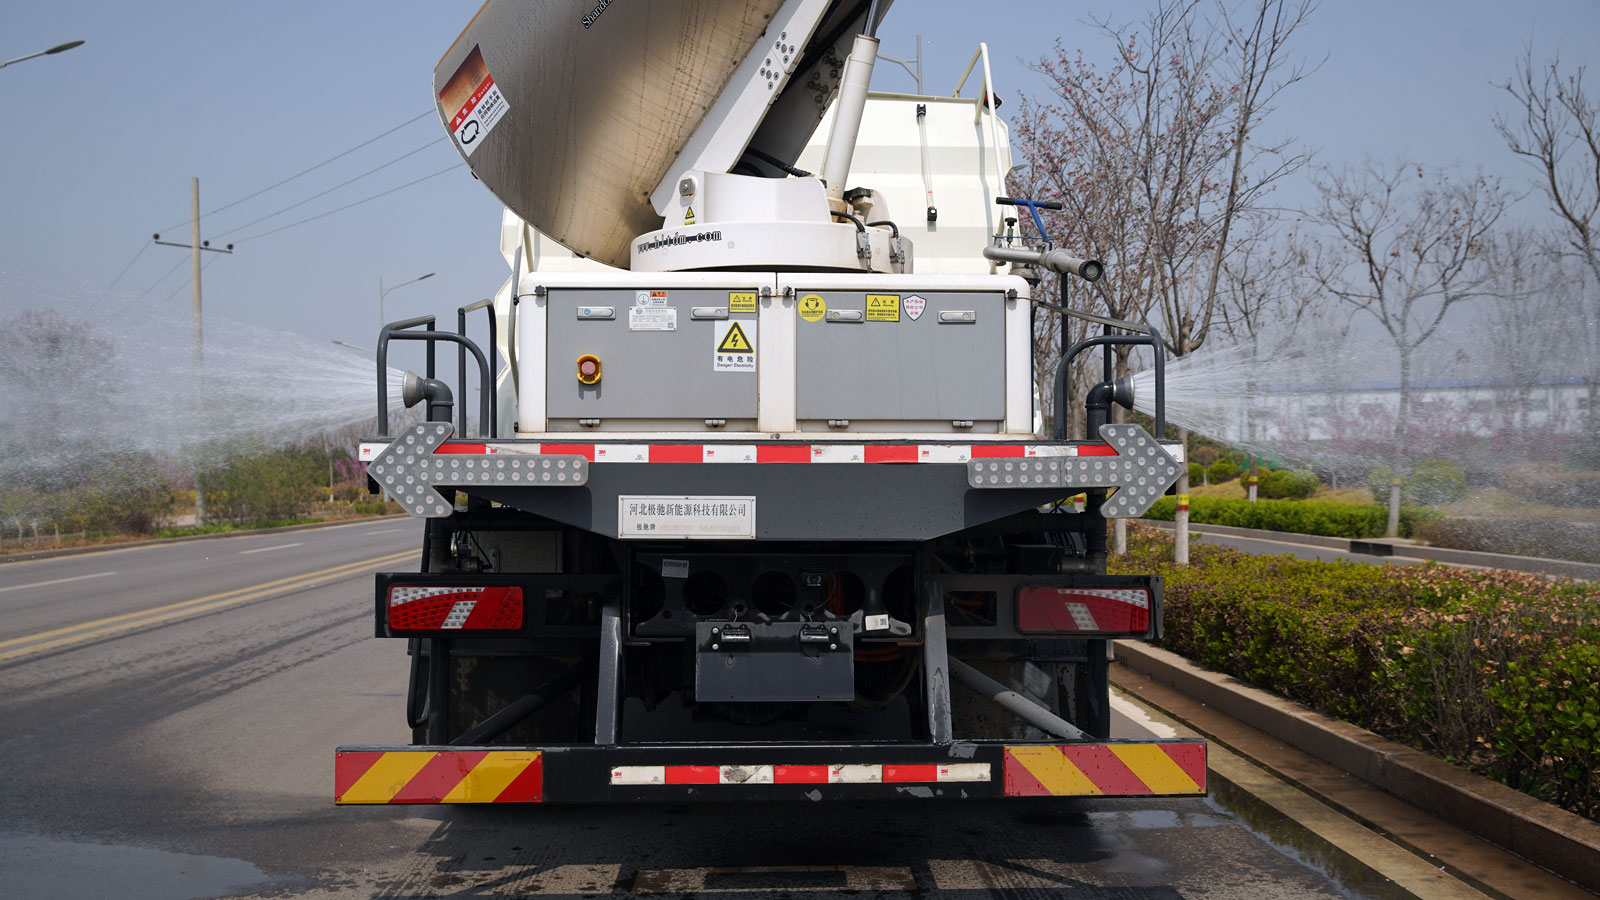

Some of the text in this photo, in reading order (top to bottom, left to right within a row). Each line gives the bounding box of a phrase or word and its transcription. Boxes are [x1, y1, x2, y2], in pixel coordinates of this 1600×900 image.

[629, 503, 746, 516] 河北极驰新能源科技有限公司
